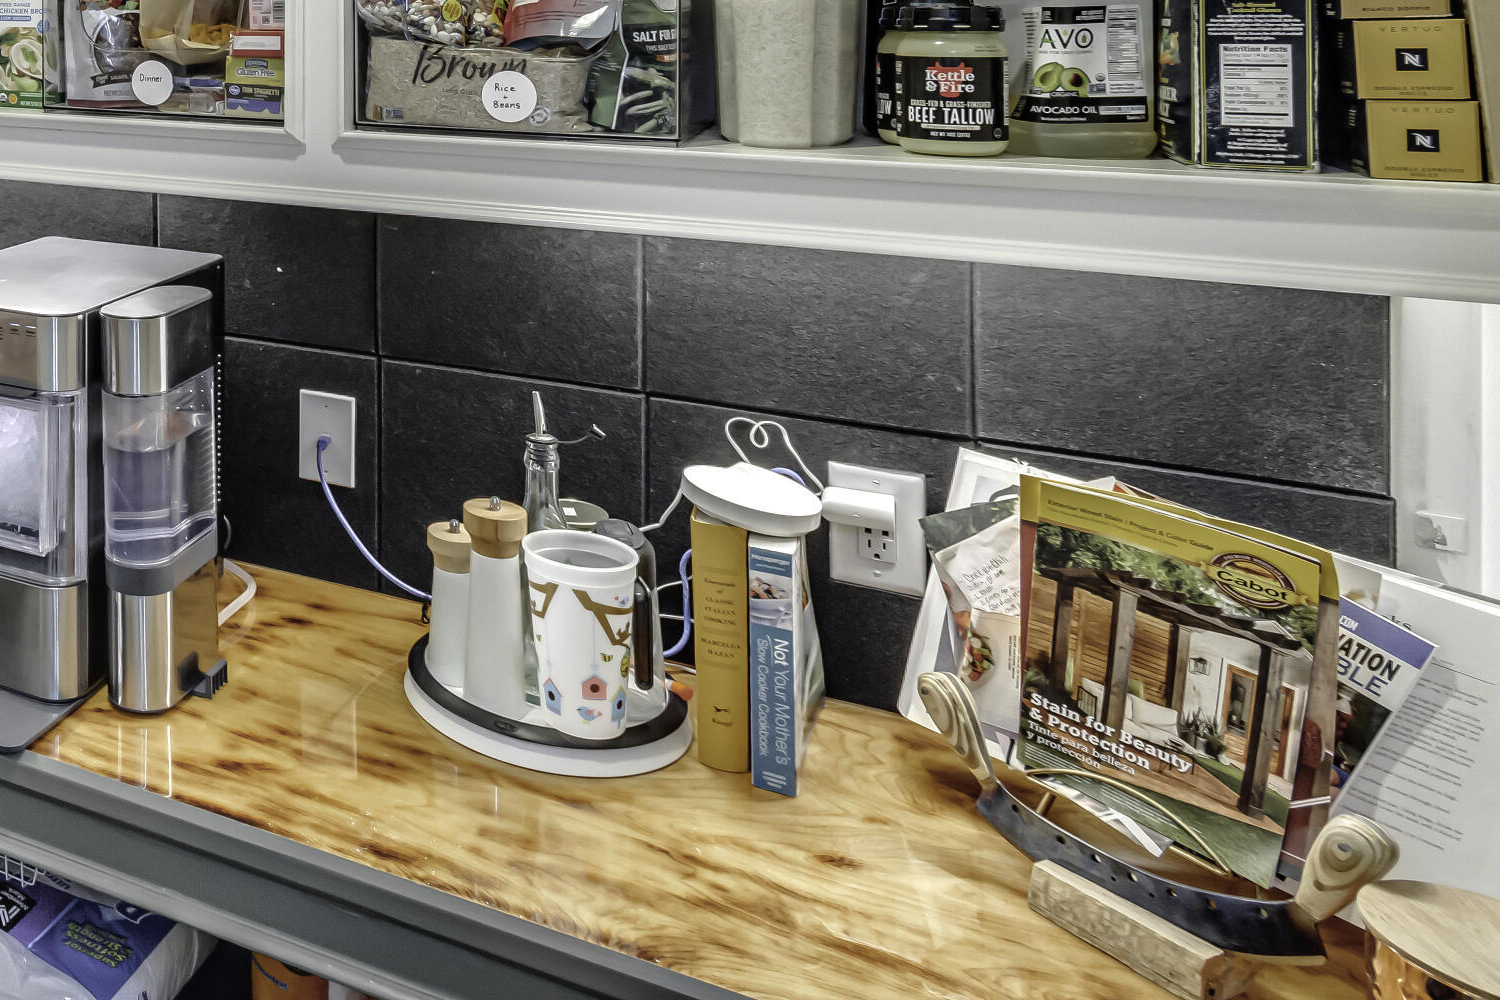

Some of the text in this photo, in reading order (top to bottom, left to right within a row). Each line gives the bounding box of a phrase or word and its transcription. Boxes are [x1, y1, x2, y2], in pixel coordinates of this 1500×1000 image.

[0, 7, 28, 15] CHICKEN
[633, 29, 657, 42] SALT
[1039, 27, 1094, 49] AVO
[1223, 45, 1288, 53] Nutrition Facts
[139, 73, 162, 83] Dinner
[925, 69, 975, 82] Kettle
[494, 82, 516, 92] Rice
[925, 81, 975, 93] & Fire
[492, 100, 521, 110] Beans
[1029, 103, 1098, 116] AVOCADO OIL
[908, 106, 995, 126] BEEF TALLOW
[1216, 569, 1289, 602] Cabot
[756, 637, 770, 757] Slow Cooker Cookbook
[773, 637, 791, 767] Not Your Mother's
[1028, 707, 1047, 724] &
[1048, 713, 1152, 771] Protection
[1030, 692, 1081, 719] Stain
[1084, 712, 1117, 738] for
[1119, 726, 1194, 775] Beauty
[1027, 729, 1035, 742] y
[1035, 731, 1102, 771] protección
[1028, 720, 1060, 741] Tinte
[1060, 733, 1093, 757] para
[1093, 742, 1137, 775] belleza
